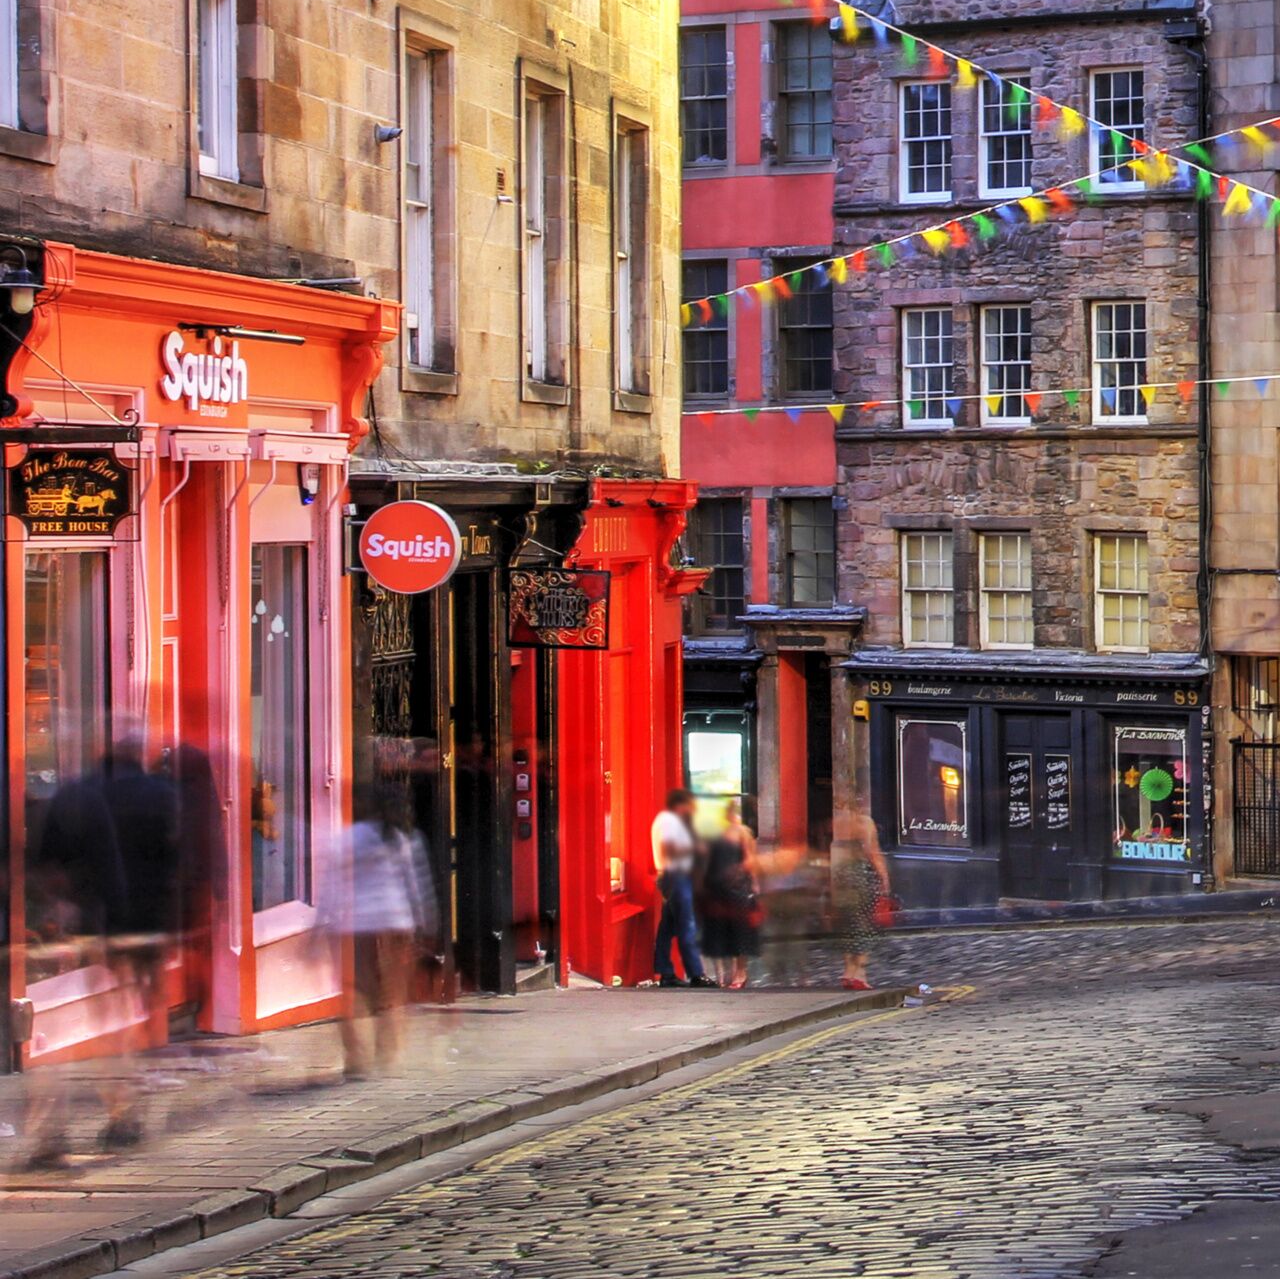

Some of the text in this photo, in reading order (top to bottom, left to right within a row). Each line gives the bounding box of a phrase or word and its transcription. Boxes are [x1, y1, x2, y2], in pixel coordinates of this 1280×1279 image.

[162, 330, 248, 410] Squish
[22, 451, 121, 483] The Bow Bar
[32, 521, 109, 532] FREE HOUSE
[366, 533, 450, 560] Squish
[869, 680, 892, 696] 89
[907, 683, 952, 696] boulangerie
[1055, 690, 1084, 703] Victoria
[1116, 692, 1158, 702] patisserie
[1174, 689, 1199, 705] 89
[1122, 730, 1136, 739] La
[909, 818, 923, 830] La
[1122, 841, 1185, 861] BONJOUR
